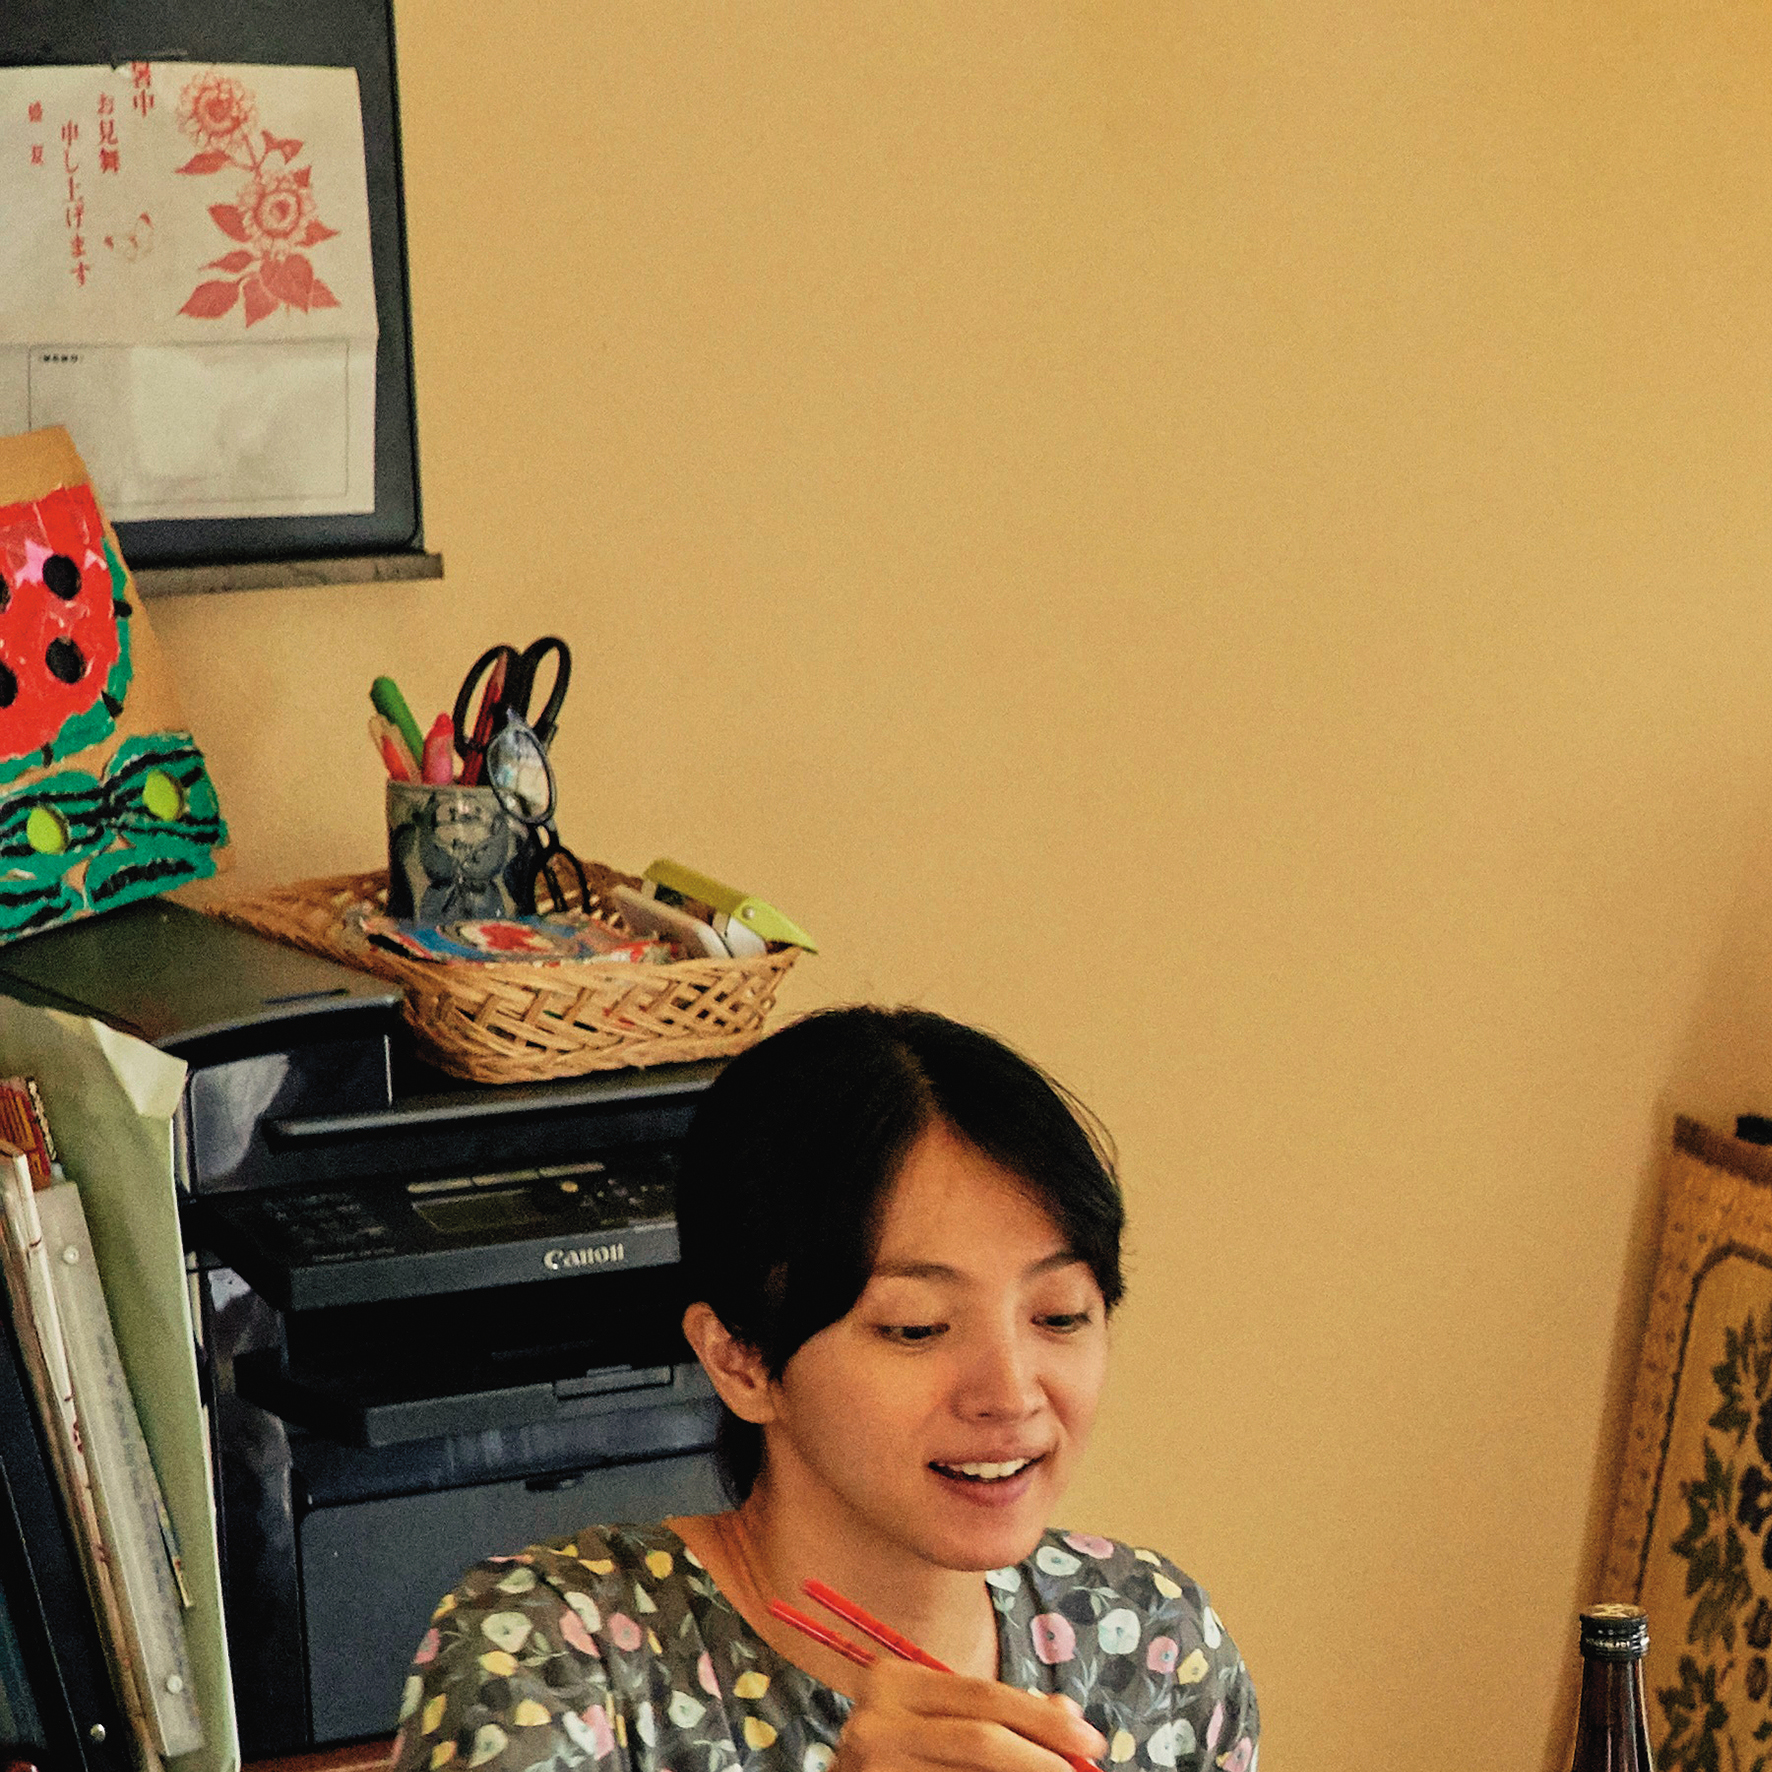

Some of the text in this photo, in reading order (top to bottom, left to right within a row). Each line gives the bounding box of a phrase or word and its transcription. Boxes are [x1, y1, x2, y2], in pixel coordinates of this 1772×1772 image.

[61, 119, 91, 287] 申し上げます
[543, 1243, 625, 1271] Canon
